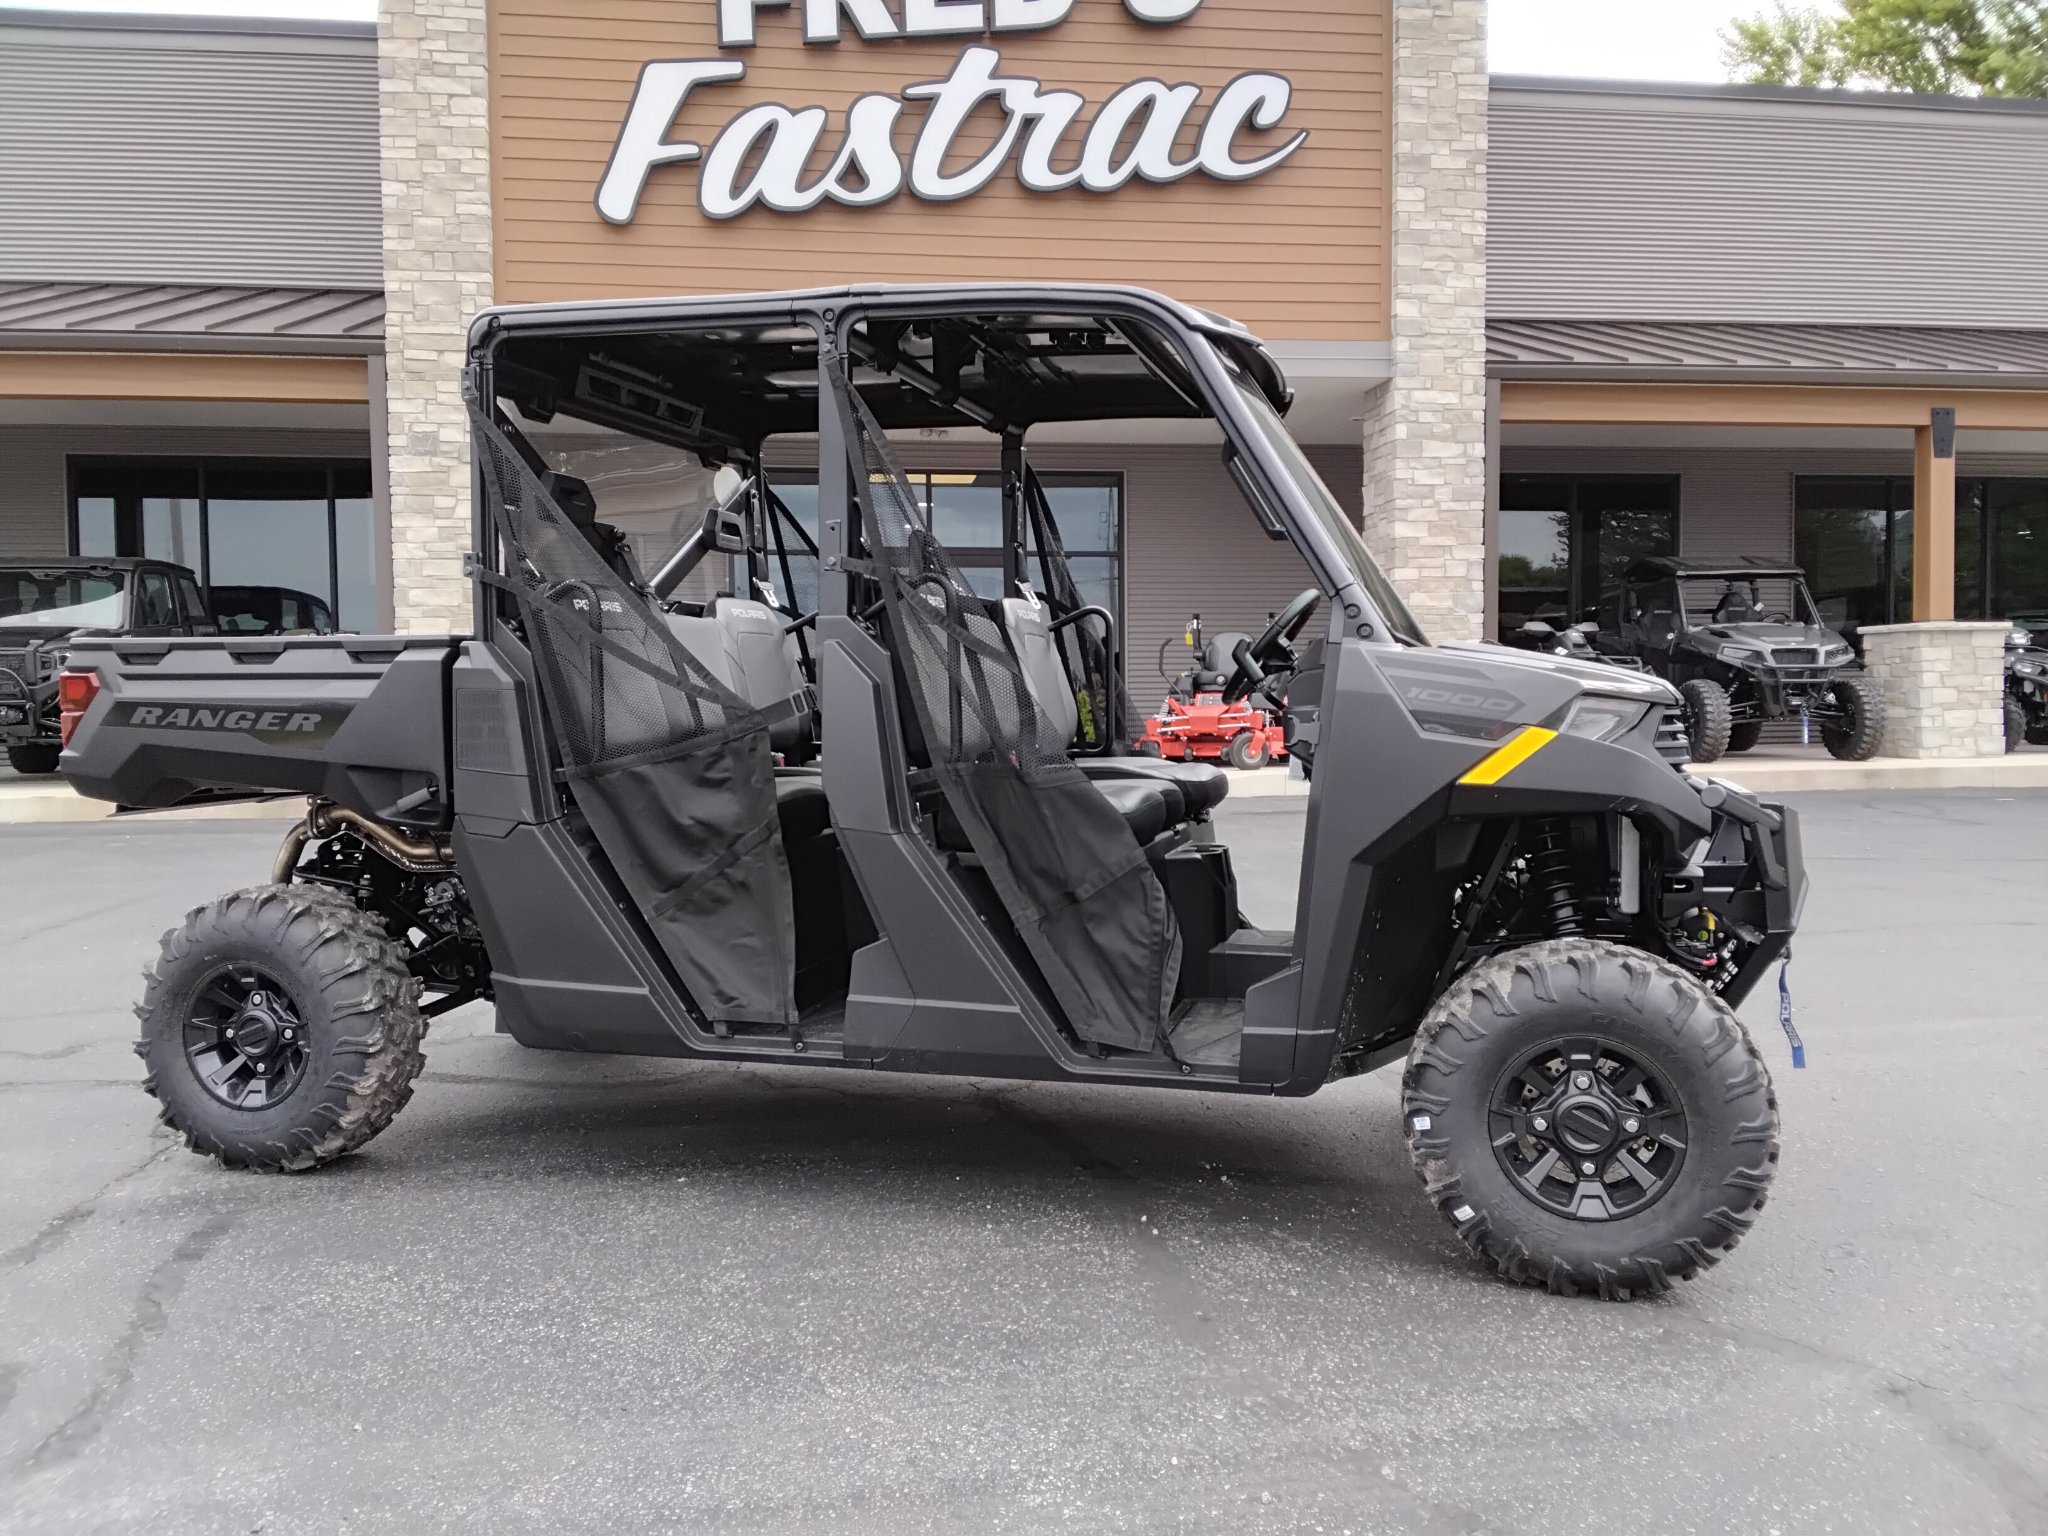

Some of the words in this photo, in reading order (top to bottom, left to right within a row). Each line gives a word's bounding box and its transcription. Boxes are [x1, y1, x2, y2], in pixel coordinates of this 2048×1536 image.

[593, 44, 1311, 226] Fastrac
[129, 706, 322, 732] RANGER
[1406, 687, 1517, 712] 1000
[1781, 992, 1802, 1048] POLARIS
